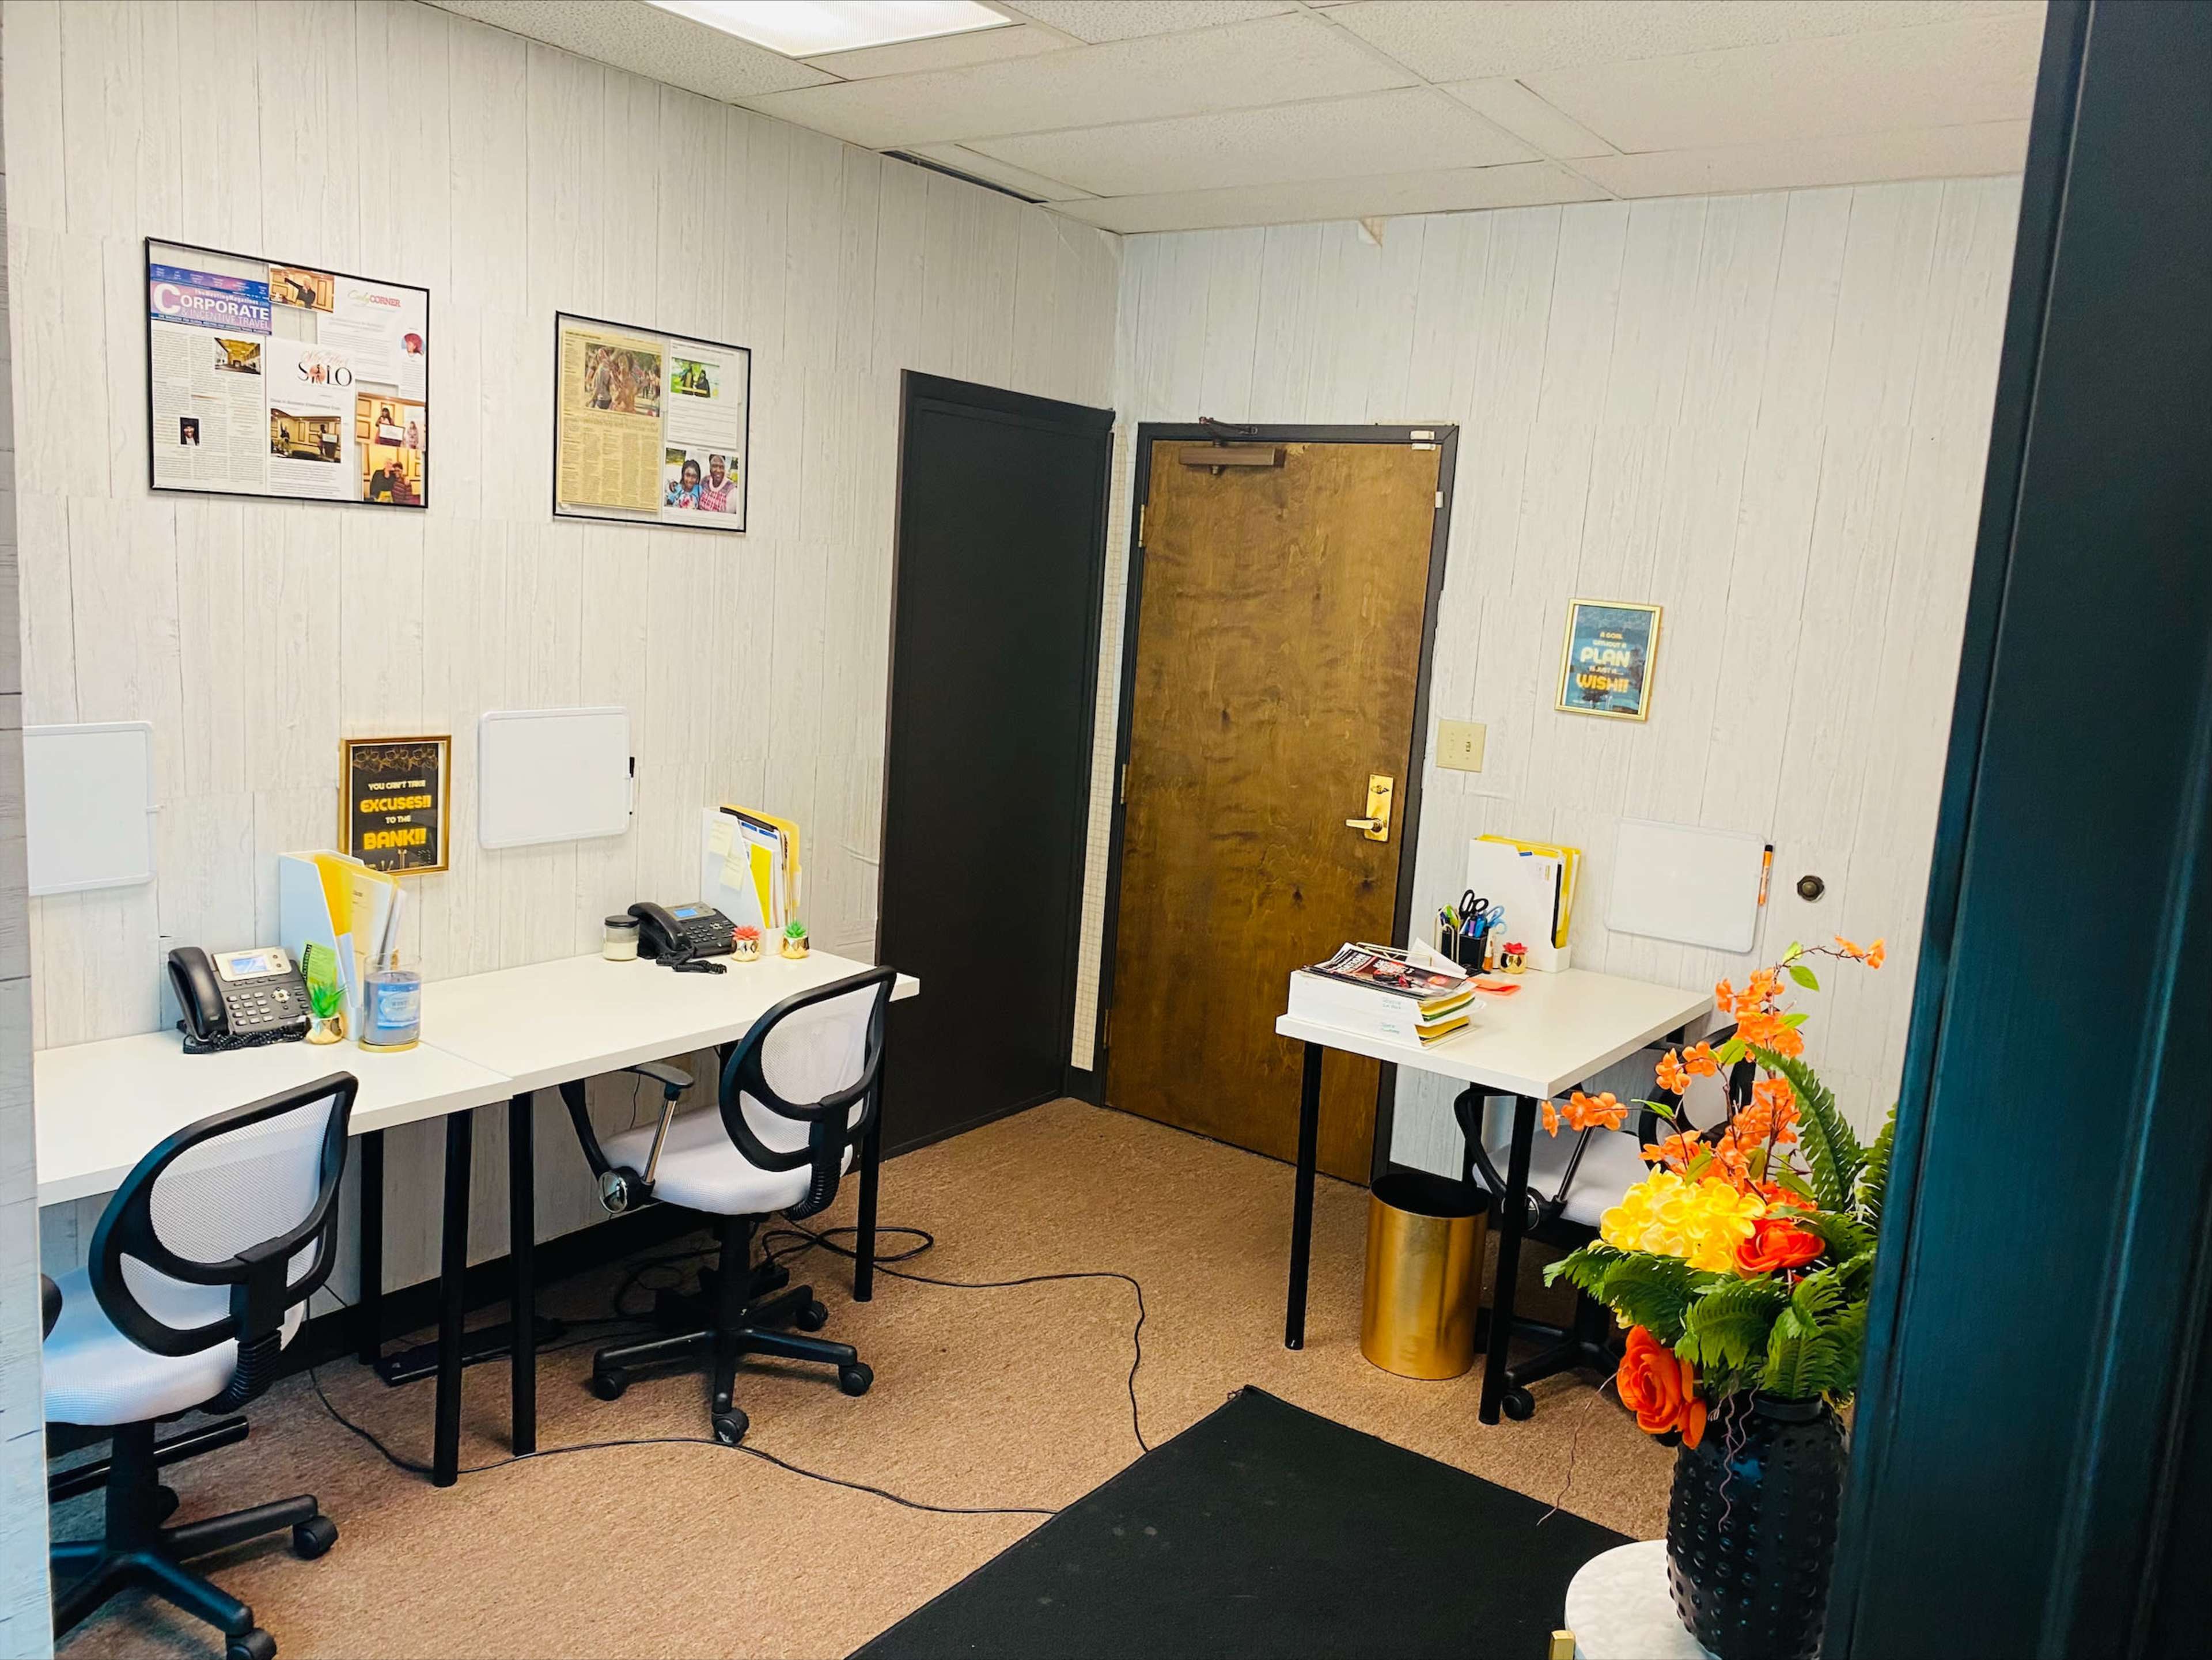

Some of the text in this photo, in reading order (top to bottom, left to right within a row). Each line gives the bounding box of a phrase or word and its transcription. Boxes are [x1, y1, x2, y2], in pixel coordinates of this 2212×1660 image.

[153, 283, 269, 321] CORPORATE
[369, 294, 401, 307] CORNER
[190, 308, 236, 325] INCENTIVE
[238, 317, 268, 328] TRAVEL
[1581, 647, 1630, 668] PLAN
[386, 781, 406, 789] CAN'T
[360, 795, 431, 813] EXCUSES!!
[363, 828, 427, 850] BANK!!
